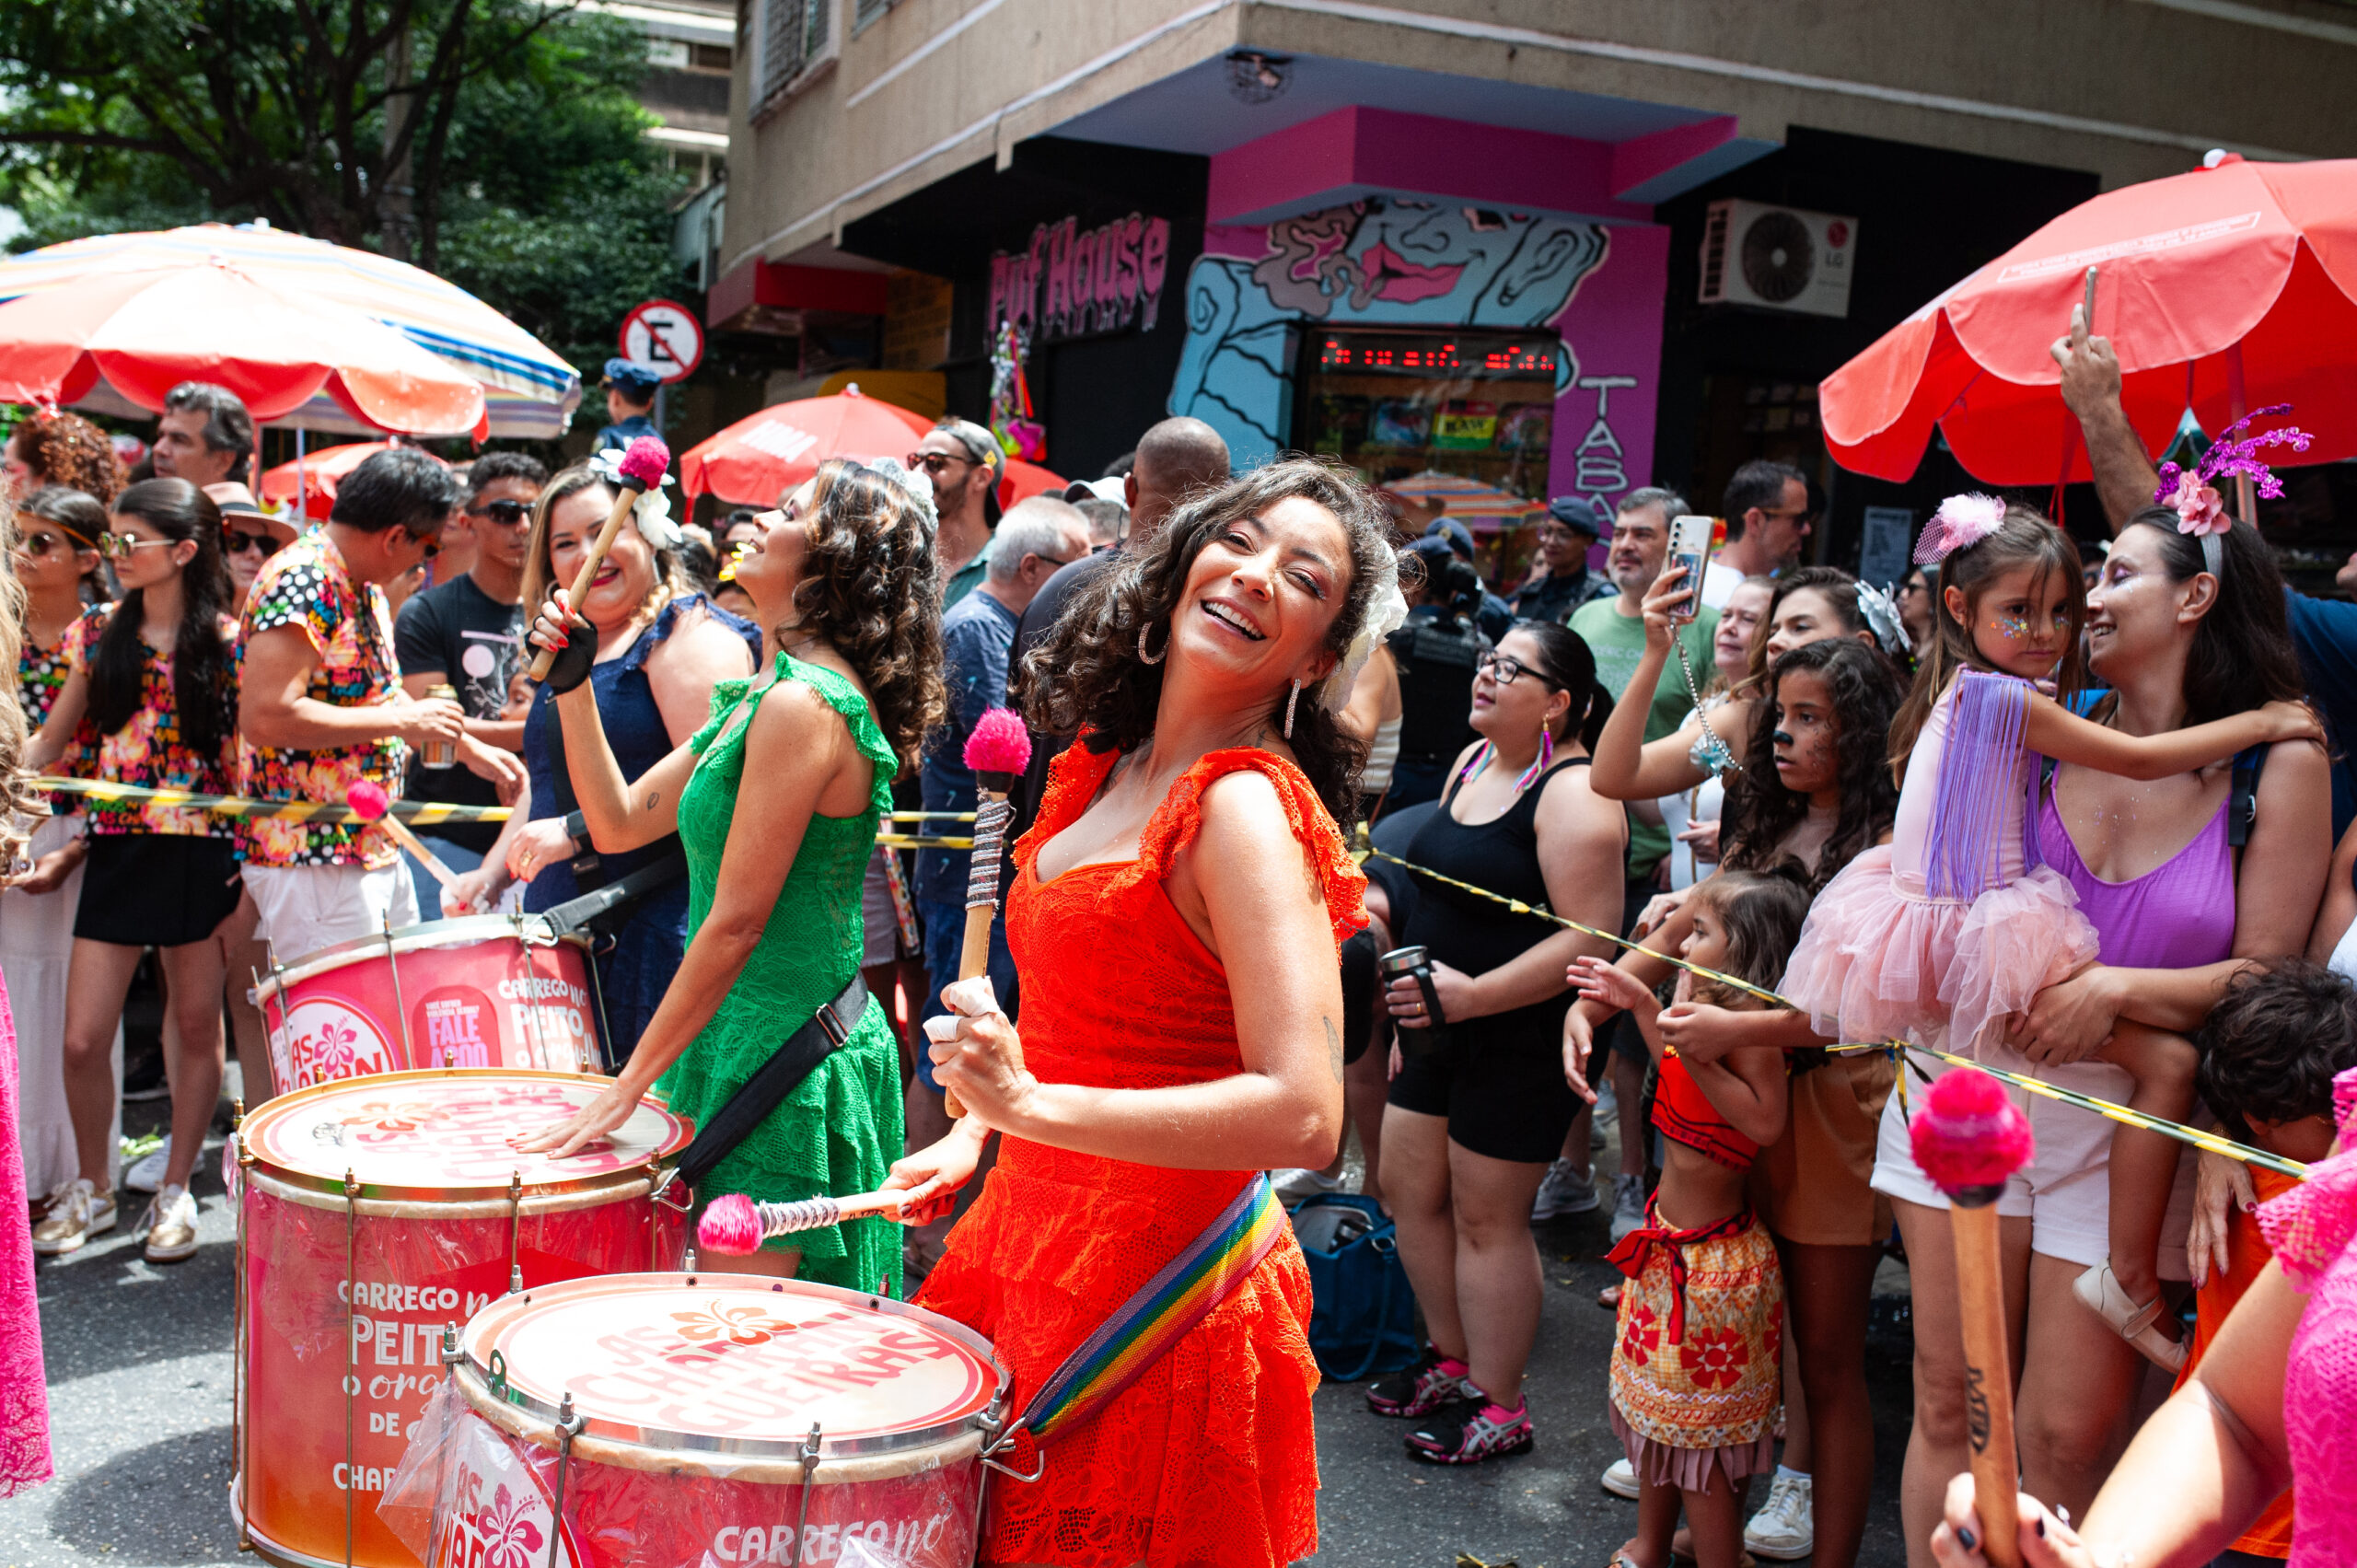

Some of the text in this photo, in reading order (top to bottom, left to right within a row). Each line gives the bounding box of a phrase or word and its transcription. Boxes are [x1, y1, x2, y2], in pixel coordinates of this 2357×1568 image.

[1044, 212, 1170, 337] House
[1826, 250, 1844, 269] LG
[650, 321, 674, 361] E
[1446, 418, 1486, 432] RAW
[1574, 376, 1637, 546] TABA
[498, 977, 569, 1000] CARREGO
[428, 1013, 482, 1047] FALE
[510, 1004, 585, 1044] PEITO
[291, 1033, 314, 1073] AS
[337, 1280, 459, 1313] CARREGO
[351, 1314, 447, 1366] PEIT
[595, 1325, 689, 1367] AS
[656, 1329, 958, 1434] GUEIRAS
[369, 1411, 400, 1436] DE
